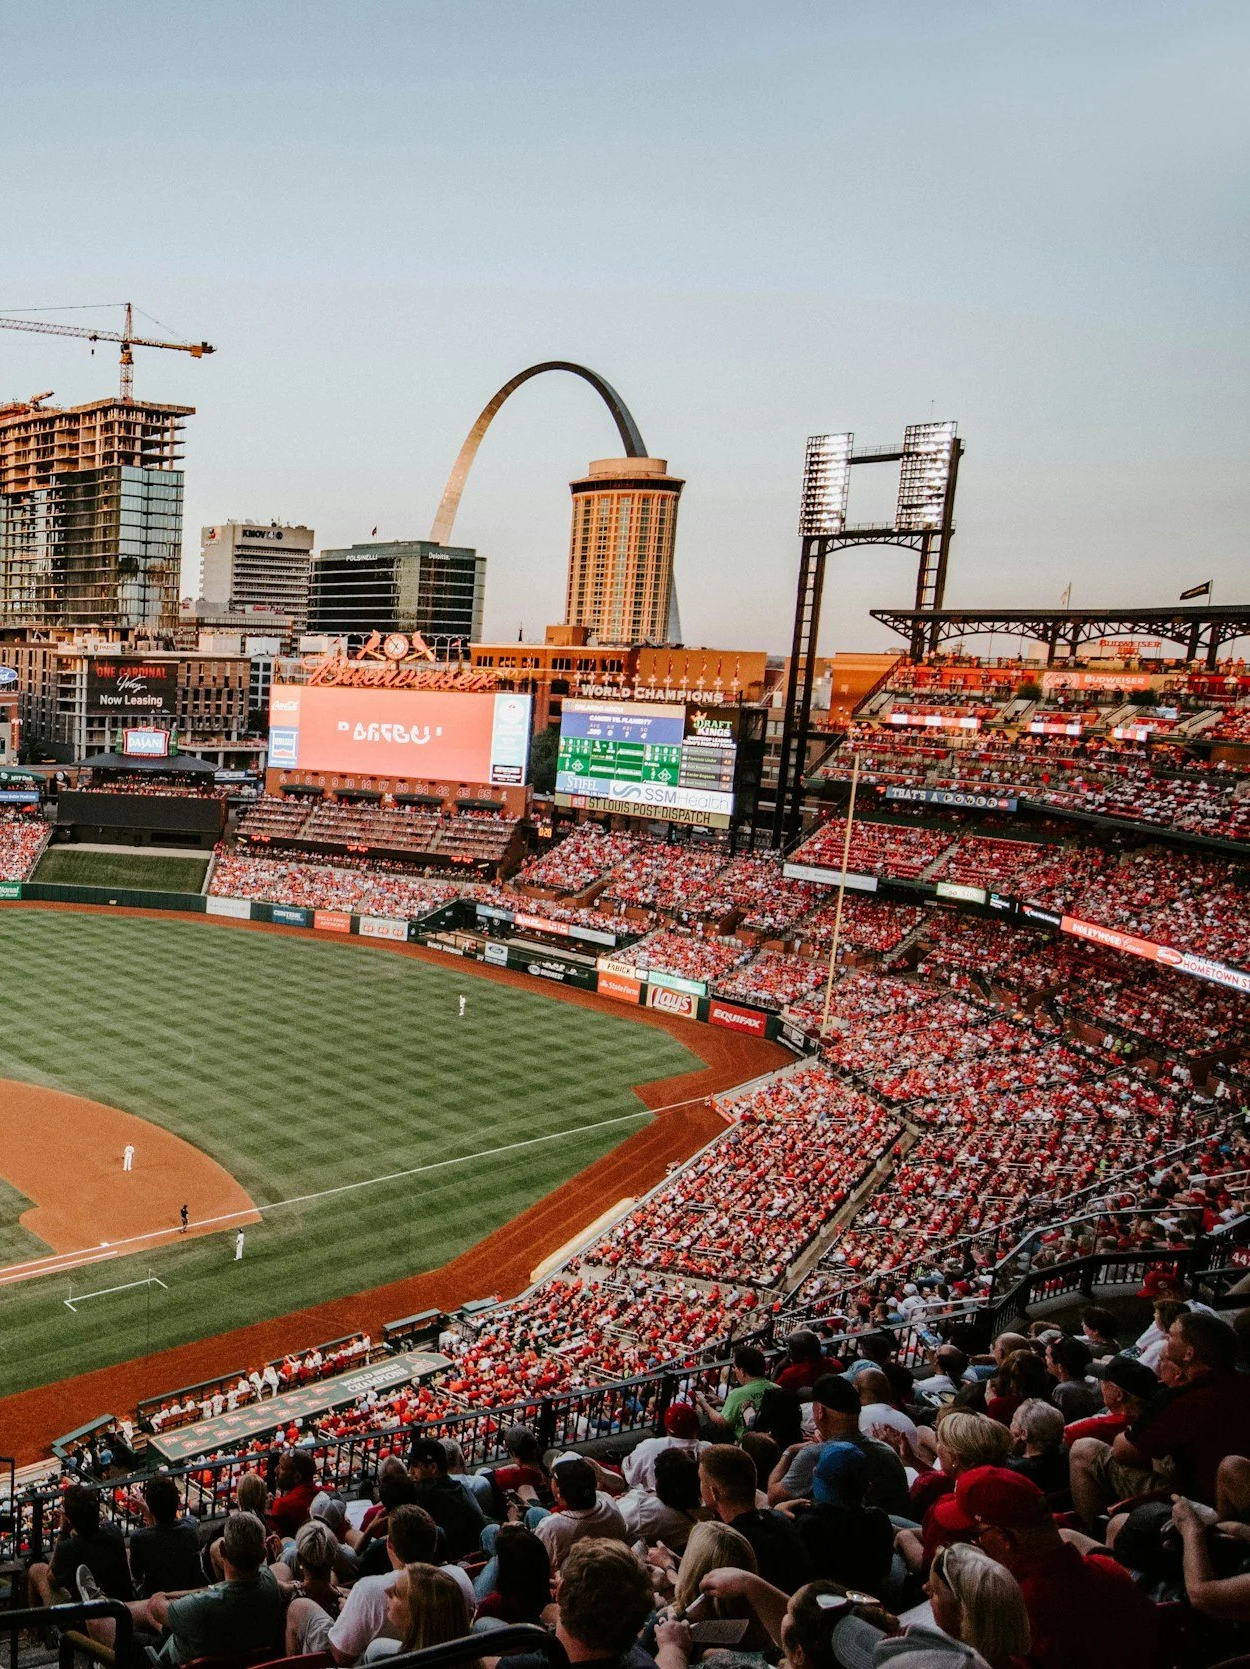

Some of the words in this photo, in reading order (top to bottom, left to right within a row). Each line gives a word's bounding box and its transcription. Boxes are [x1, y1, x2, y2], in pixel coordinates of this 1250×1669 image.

[242, 529, 266, 539] KMOV
[346, 554, 378, 562] POLSINELLI
[1099, 639, 1161, 648] BUDWEISER
[96, 666, 117, 678] ONE
[119, 667, 167, 679] CARDINAL
[301, 654, 497, 690] Budweiser
[116, 672, 147, 694] Way
[1084, 674, 1145, 685] BUDWEISER
[581, 683, 630, 698] WORLD
[634, 686, 724, 703] CHAMPIONS
[99, 694, 122, 706] Now
[124, 694, 163, 707] Leasing
[695, 719, 732, 729] DRAFT
[696, 727, 731, 738] KINGS
[128, 736, 163, 749] DASANI
[318, 776, 325, 787] 6
[331, 777, 339, 788] 9
[378, 781, 389, 792] 17
[436, 785, 450, 797] 42
[456, 787, 471, 799] 45
[567, 776, 597, 791] STIFEL
[892, 787, 927, 801] THAT'S
[930, 792, 939, 802] A
[603, 800, 630, 814] LOUIS
[633, 802, 711, 825] POST-DISPATCH
[1072, 923, 1122, 945] HOLLYWOOD
[540, 968, 564, 980] MIDWEST
[607, 963, 631, 975] FABICK
[1183, 959, 1239, 985] HOMETOWN
[712, 1008, 763, 1029] EQUIFAX
[339, 1373, 373, 1387] WORLD
[347, 1368, 408, 1392] CHAMPIONS
